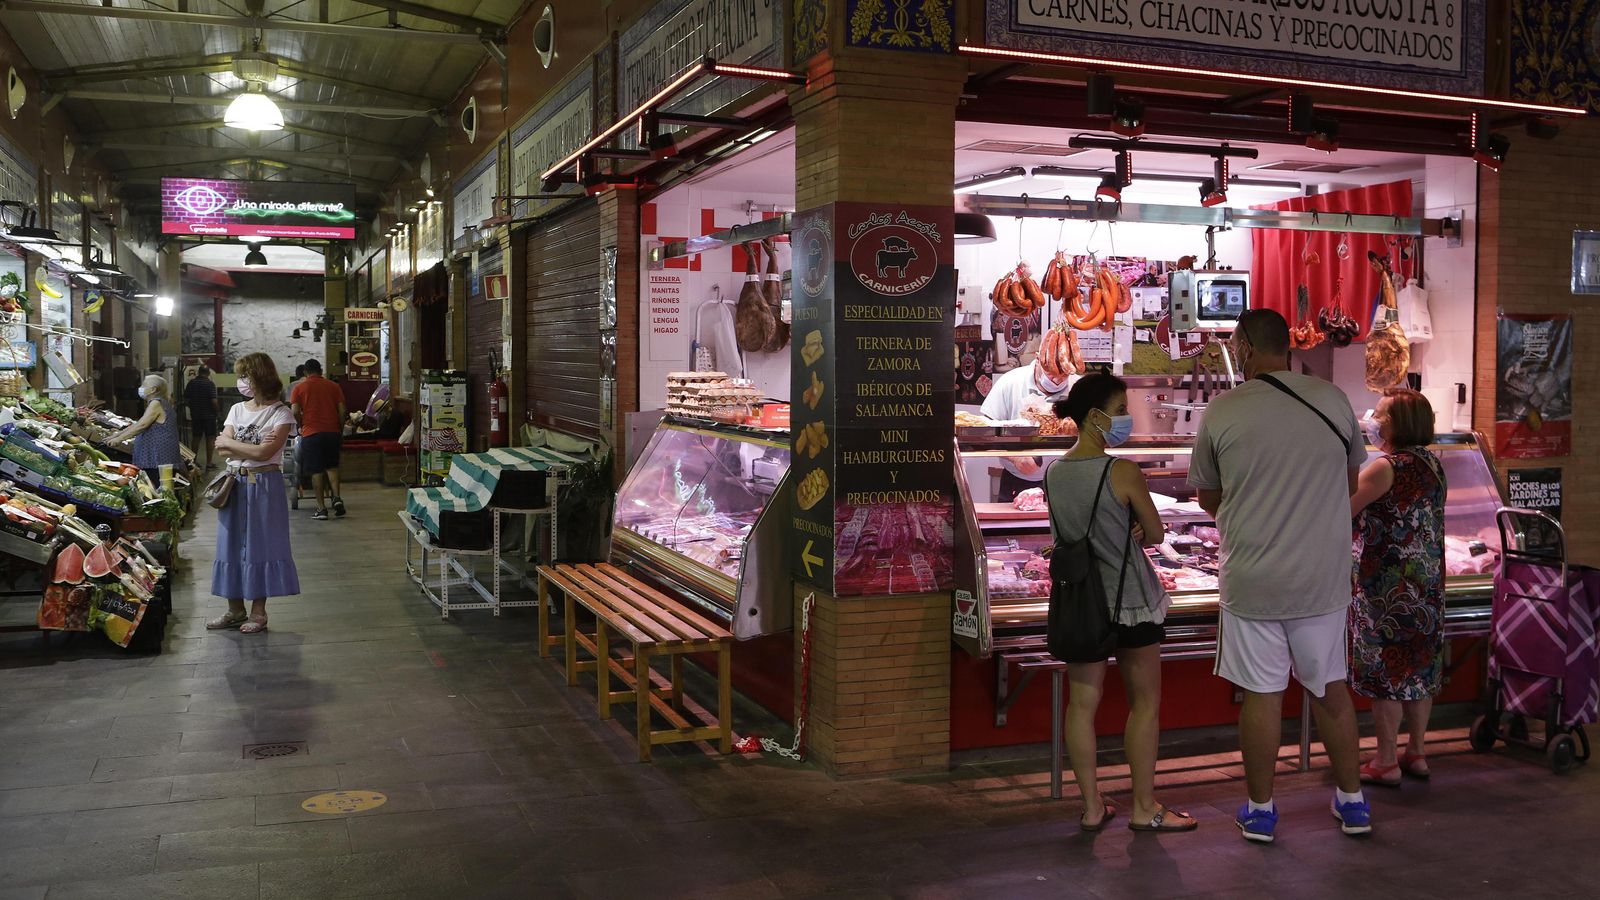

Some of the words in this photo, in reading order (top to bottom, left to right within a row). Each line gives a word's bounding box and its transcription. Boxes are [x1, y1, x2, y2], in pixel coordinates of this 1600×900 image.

[1446, 3, 1454, 28] 8
[1028, 0, 1133, 29] CARNES,
[1139, 1, 1262, 40] CHACINAS
[1269, 15, 1285, 42] Y
[1291, 18, 1453, 62] PRECOCINADOS
[259, 199, 296, 211] mirada
[298, 201, 344, 212] diferente?
[848, 213, 892, 239] Carlos
[896, 210, 942, 243] Acosta
[858, 274, 931, 294] CARNICERÍA
[347, 309, 384, 320] CARNICERÍA
[844, 305, 925, 319] ESPECIALIDAD
[928, 306, 943, 319] EN
[856, 337, 912, 350] TERNERA
[916, 337, 932, 350] DE
[867, 357, 921, 371] ZAMORA
[857, 379, 913, 397] IBÉRICOS
[916, 383, 932, 396] DE
[855, 403, 934, 417] SALAMANCA
[880, 430, 908, 443] MINI
[843, 449, 945, 465] HAMBURGUESAS
[890, 471, 899, 484] Y
[1509, 482, 1540, 491] NOCHES
[1549, 482, 1560, 490] LOS
[847, 489, 940, 506] PRECOCINADOS
[1510, 490, 1548, 499] JARDINES
[1527, 497, 1560, 508] ALCÁZAR
[792, 517, 833, 538] PRECOCINADOS
